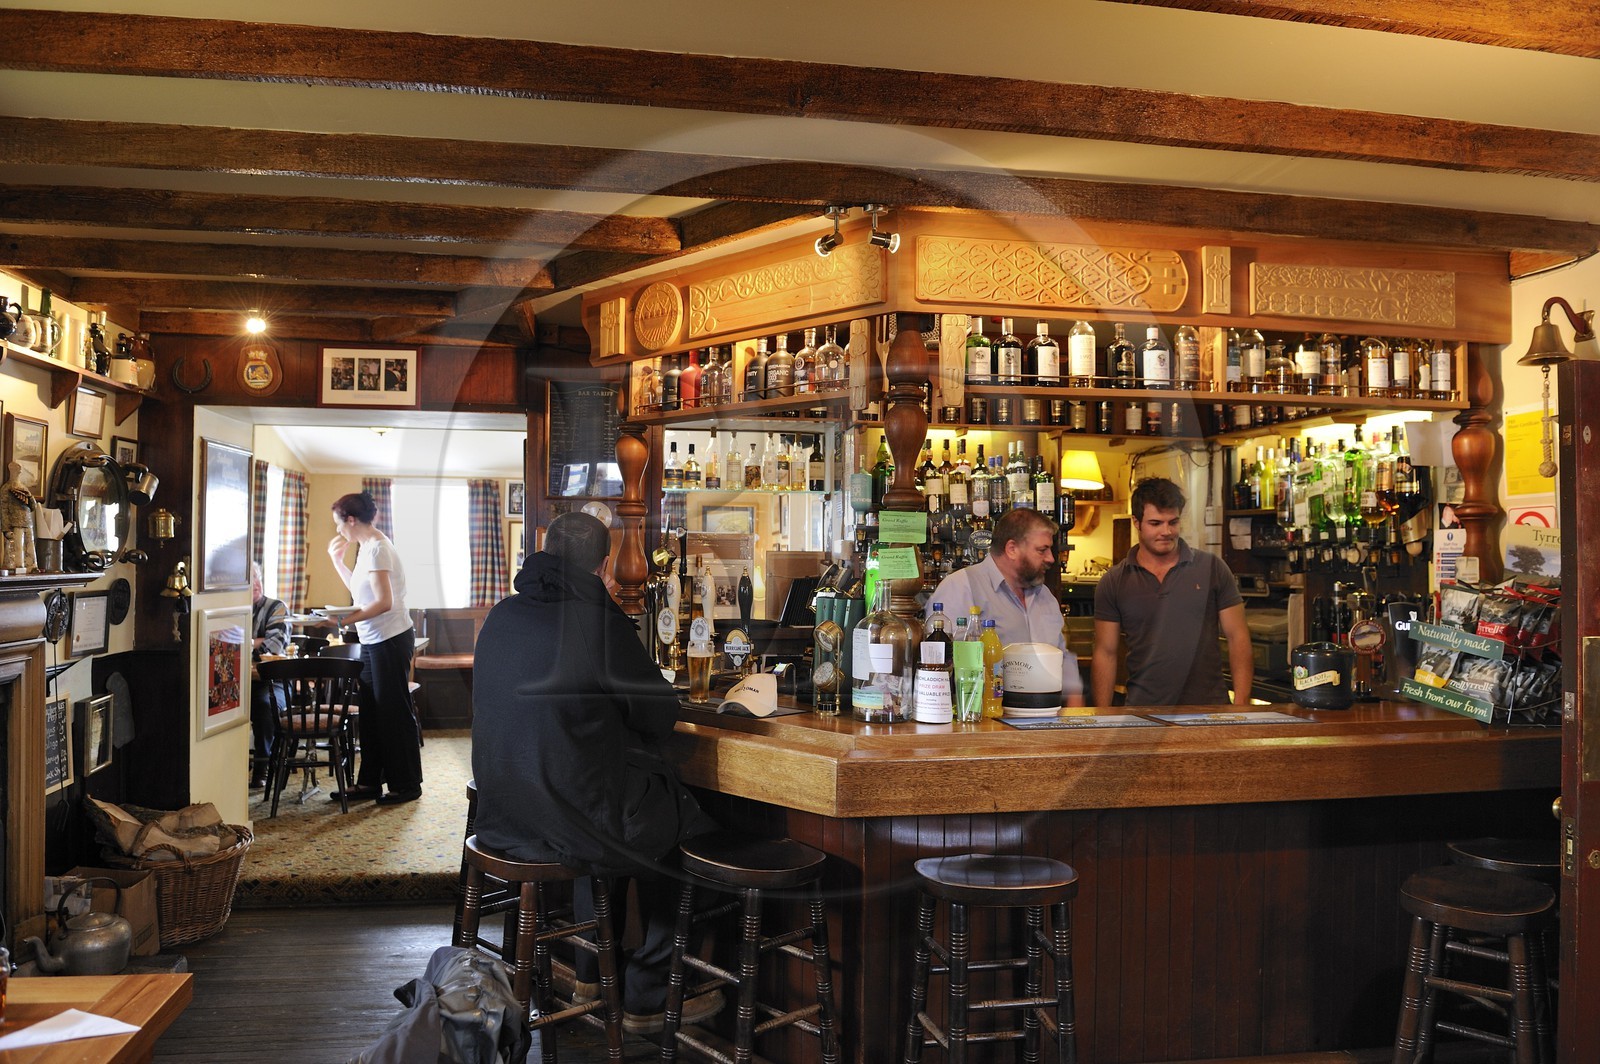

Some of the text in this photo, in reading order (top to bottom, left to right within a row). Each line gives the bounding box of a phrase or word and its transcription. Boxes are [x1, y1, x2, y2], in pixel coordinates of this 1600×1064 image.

[1395, 621, 1410, 631] GUI
[1417, 624, 1463, 648] Naturally
[1463, 636, 1492, 652] made
[1401, 682, 1488, 718] Fresh from our farm
